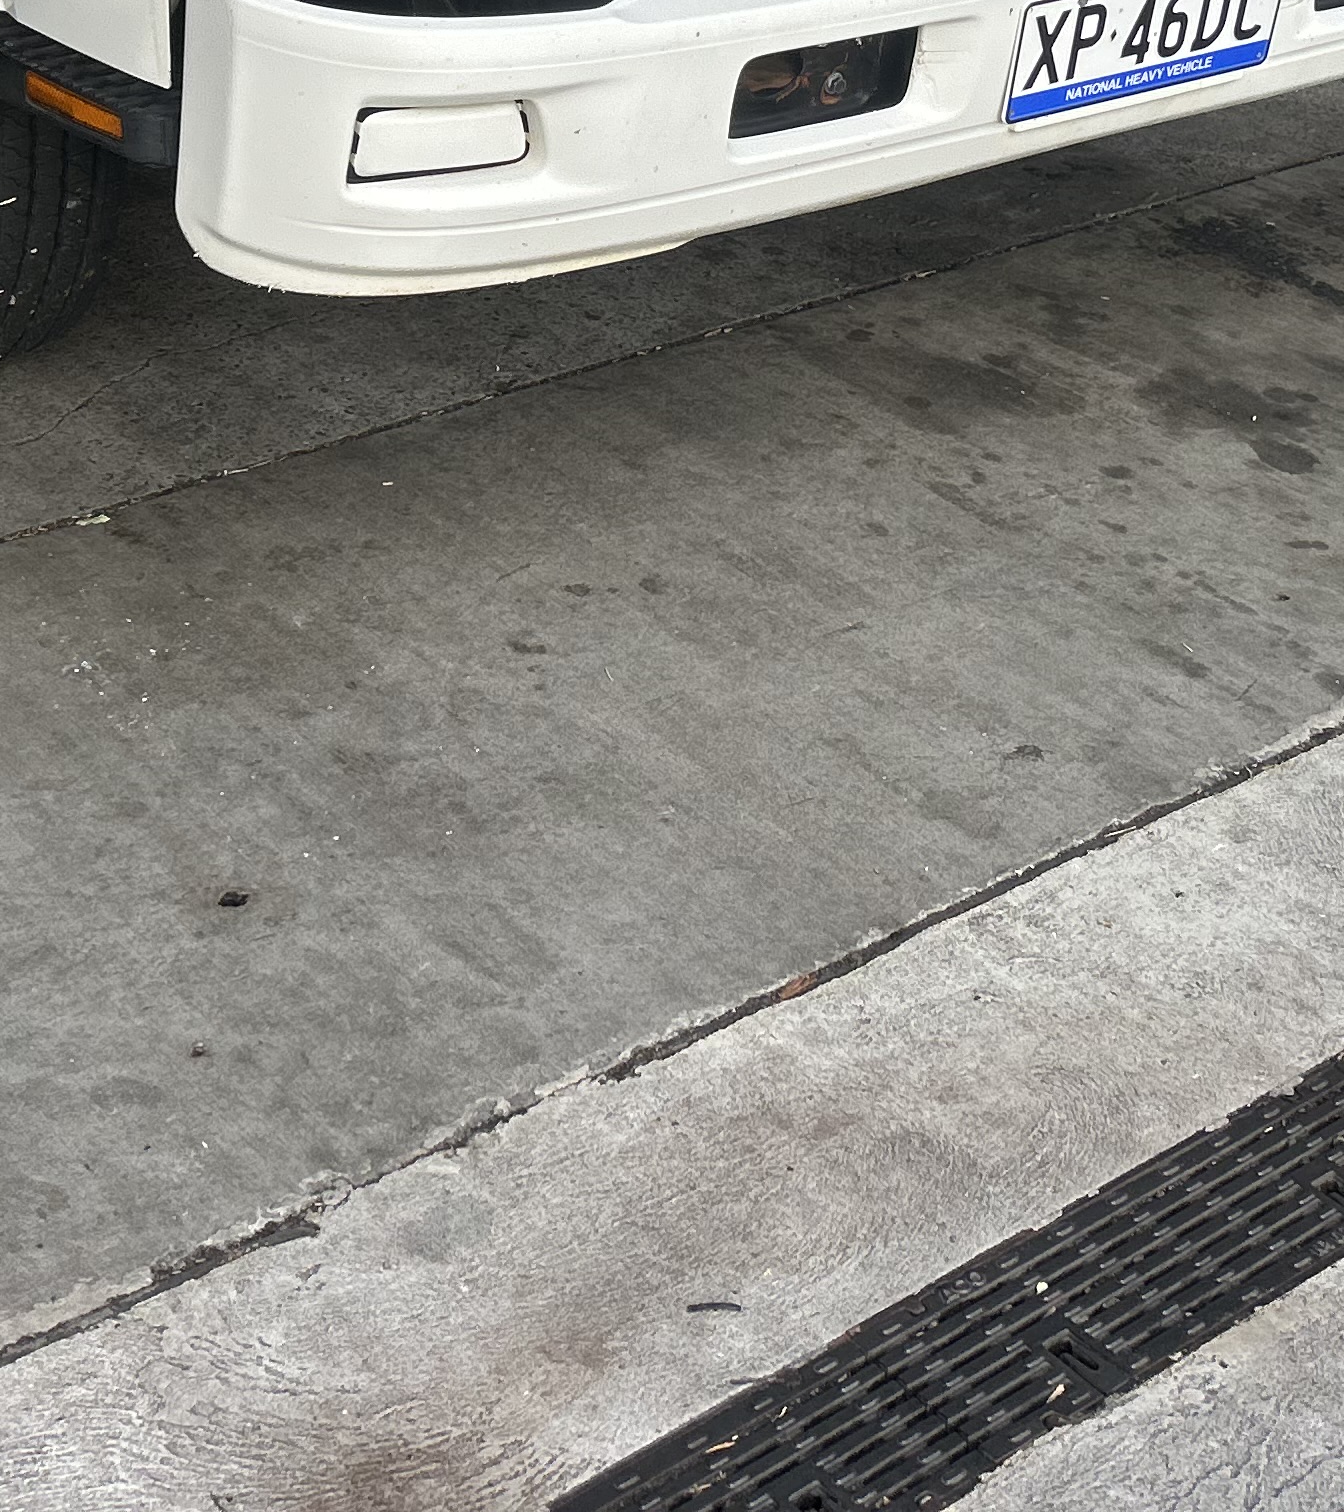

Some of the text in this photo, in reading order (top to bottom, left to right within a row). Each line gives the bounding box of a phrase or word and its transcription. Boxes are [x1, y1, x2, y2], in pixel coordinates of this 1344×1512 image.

[1064, 55, 1214, 101] NATIONAL HEAVY VEHICLE
